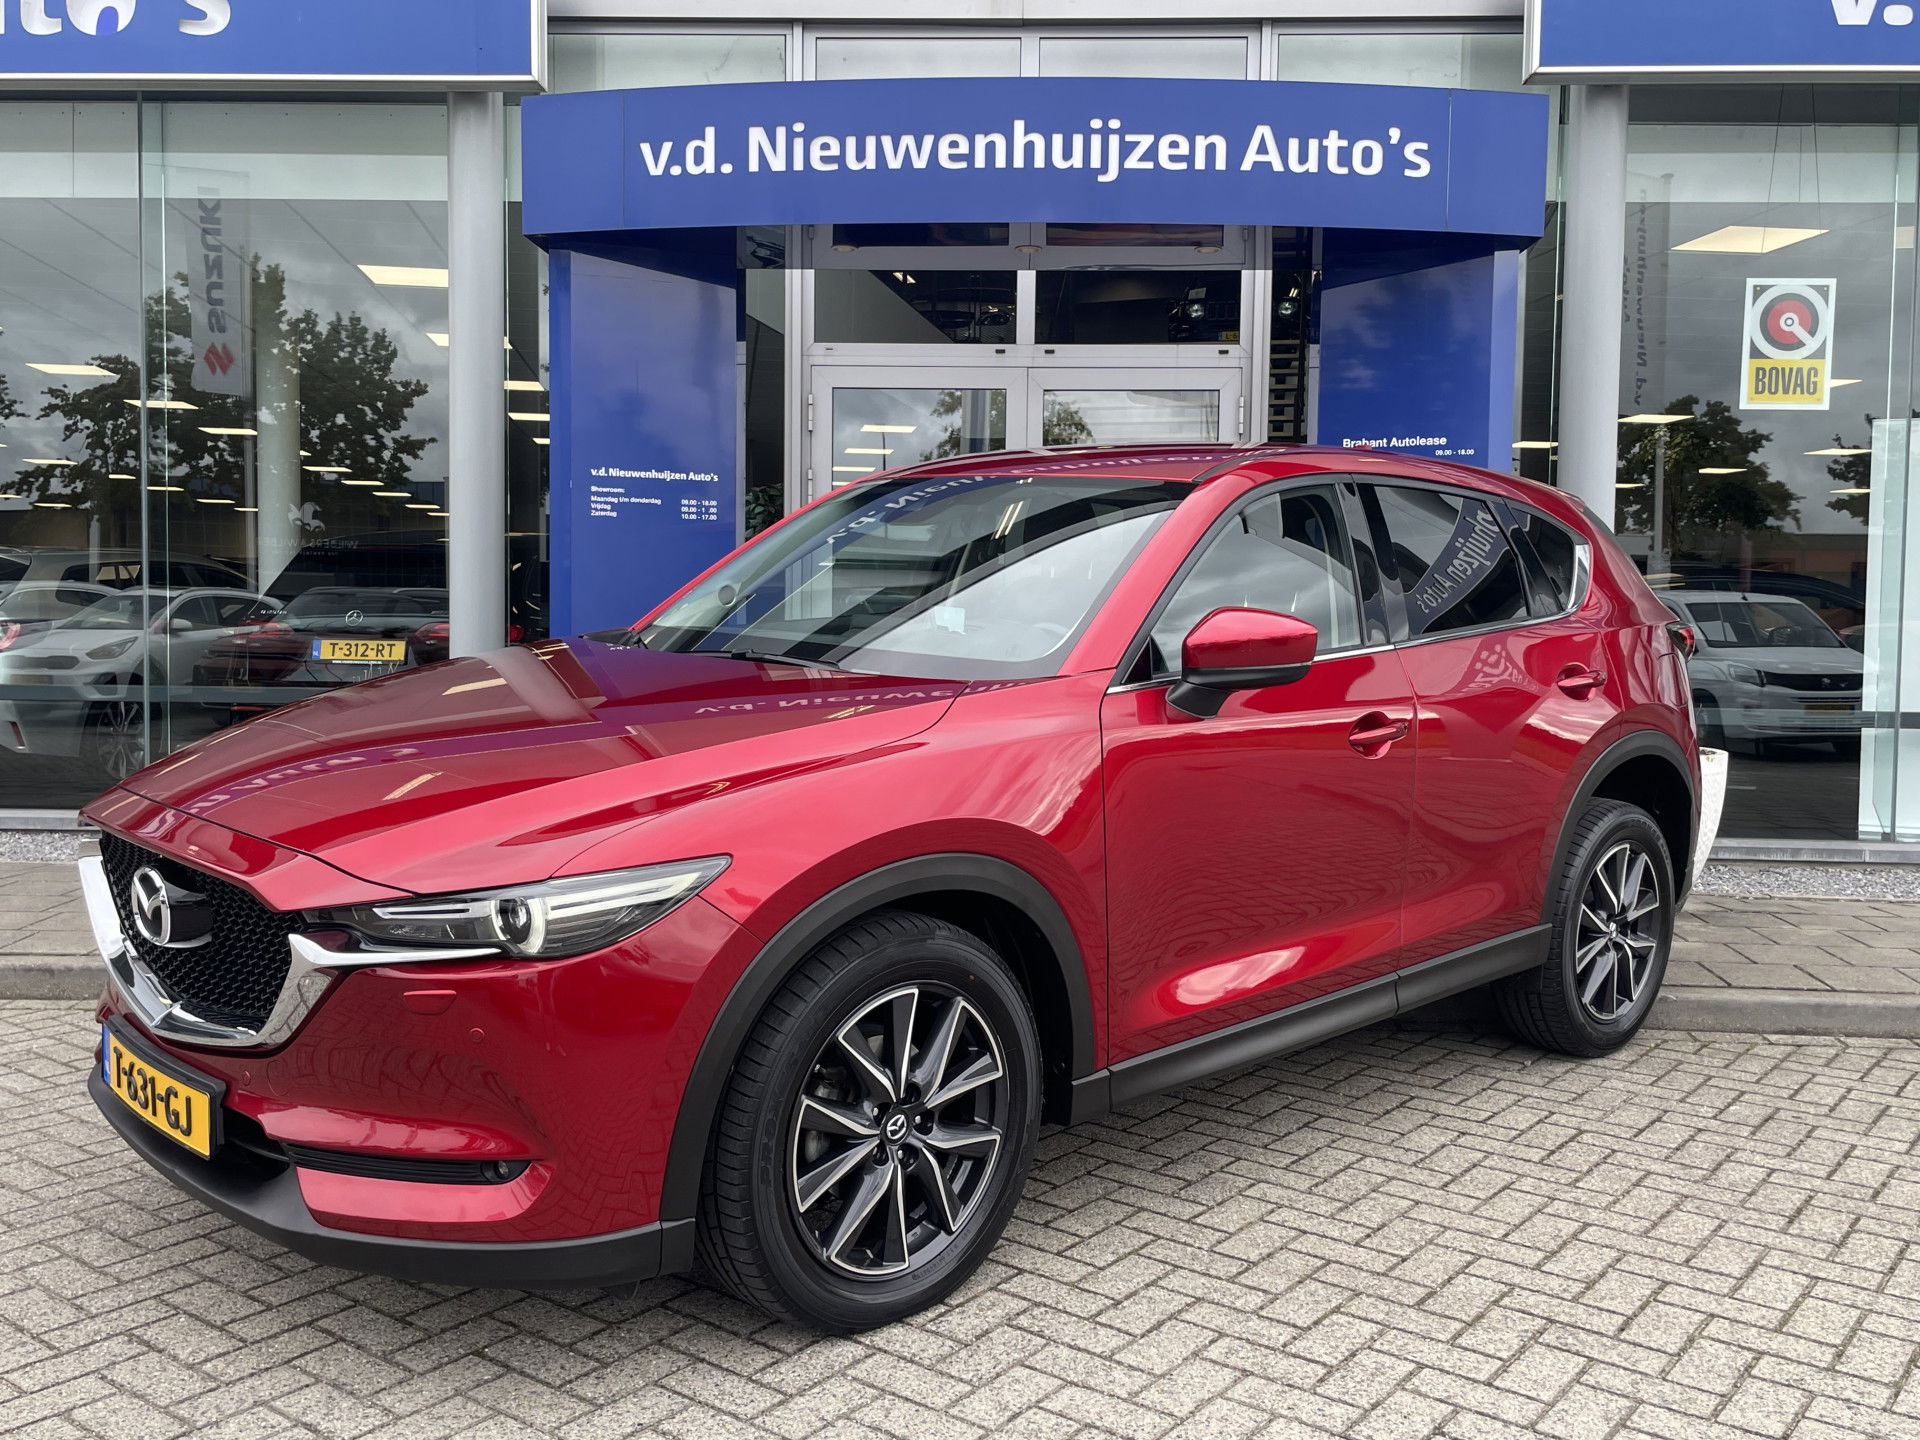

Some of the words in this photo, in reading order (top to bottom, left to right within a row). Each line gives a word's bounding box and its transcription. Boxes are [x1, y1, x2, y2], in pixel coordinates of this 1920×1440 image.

[640, 126, 733, 177] v.d.
[748, 118, 1228, 183] Nieuwenhuijzen
[1240, 124, 1431, 178] Auto's
[1754, 366, 1819, 395] BOVAG
[1390, 435, 1447, 447] Autolease
[591, 467, 607, 476] v.d.
[608, 468, 687, 481] Nieuwenhuijzen
[688, 472, 719, 481] Auto's
[590, 495, 618, 503] Maandag
[630, 497, 661, 505] donderdag
[590, 502, 611, 510] Vrijdag
[590, 509, 617, 517] Zaterdag
[330, 642, 396, 658] T-312-RT
[113, 1046, 192, 1137] T-631-GJ
